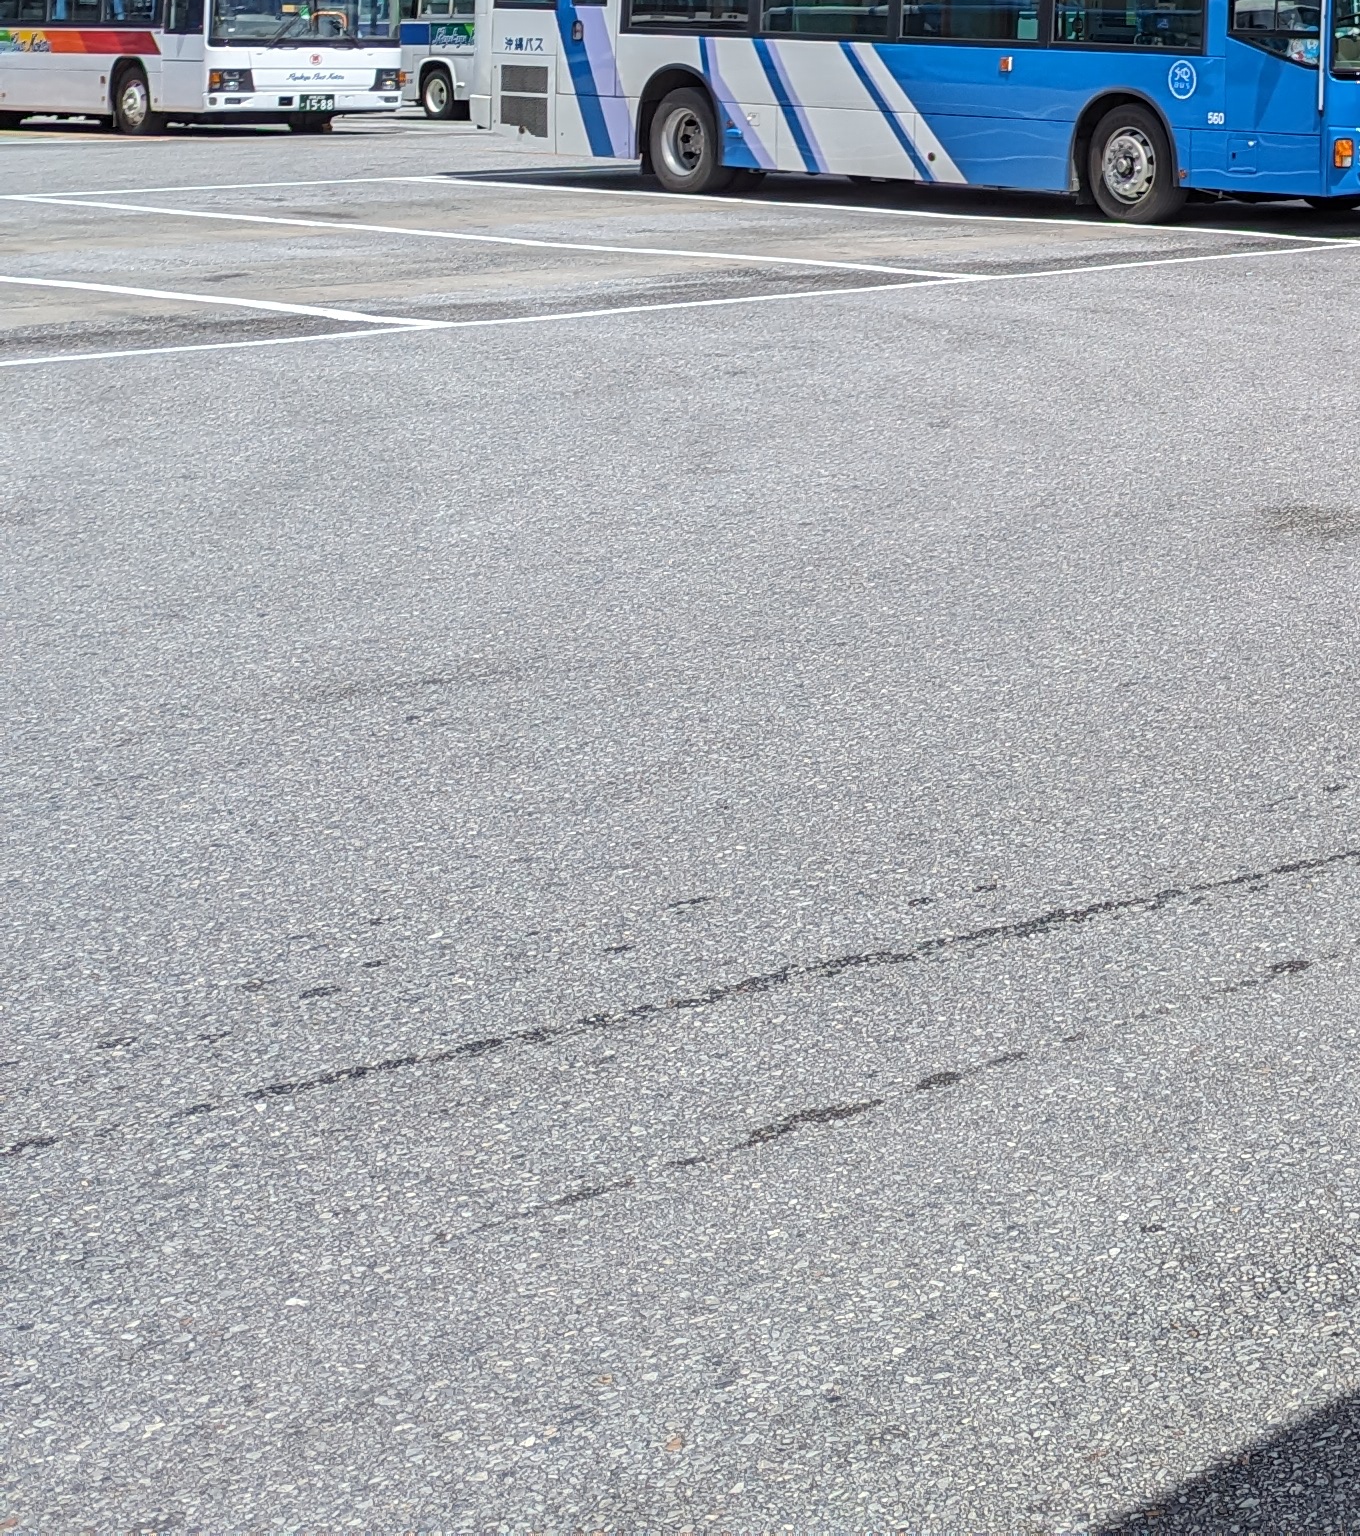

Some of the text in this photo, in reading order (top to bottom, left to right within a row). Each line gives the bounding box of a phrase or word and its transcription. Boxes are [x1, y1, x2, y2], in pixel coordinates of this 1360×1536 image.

[504, 36, 544, 51] 沖縄バス
[305, 99, 334, 111] 15-88
[1207, 111, 1225, 124] 560
